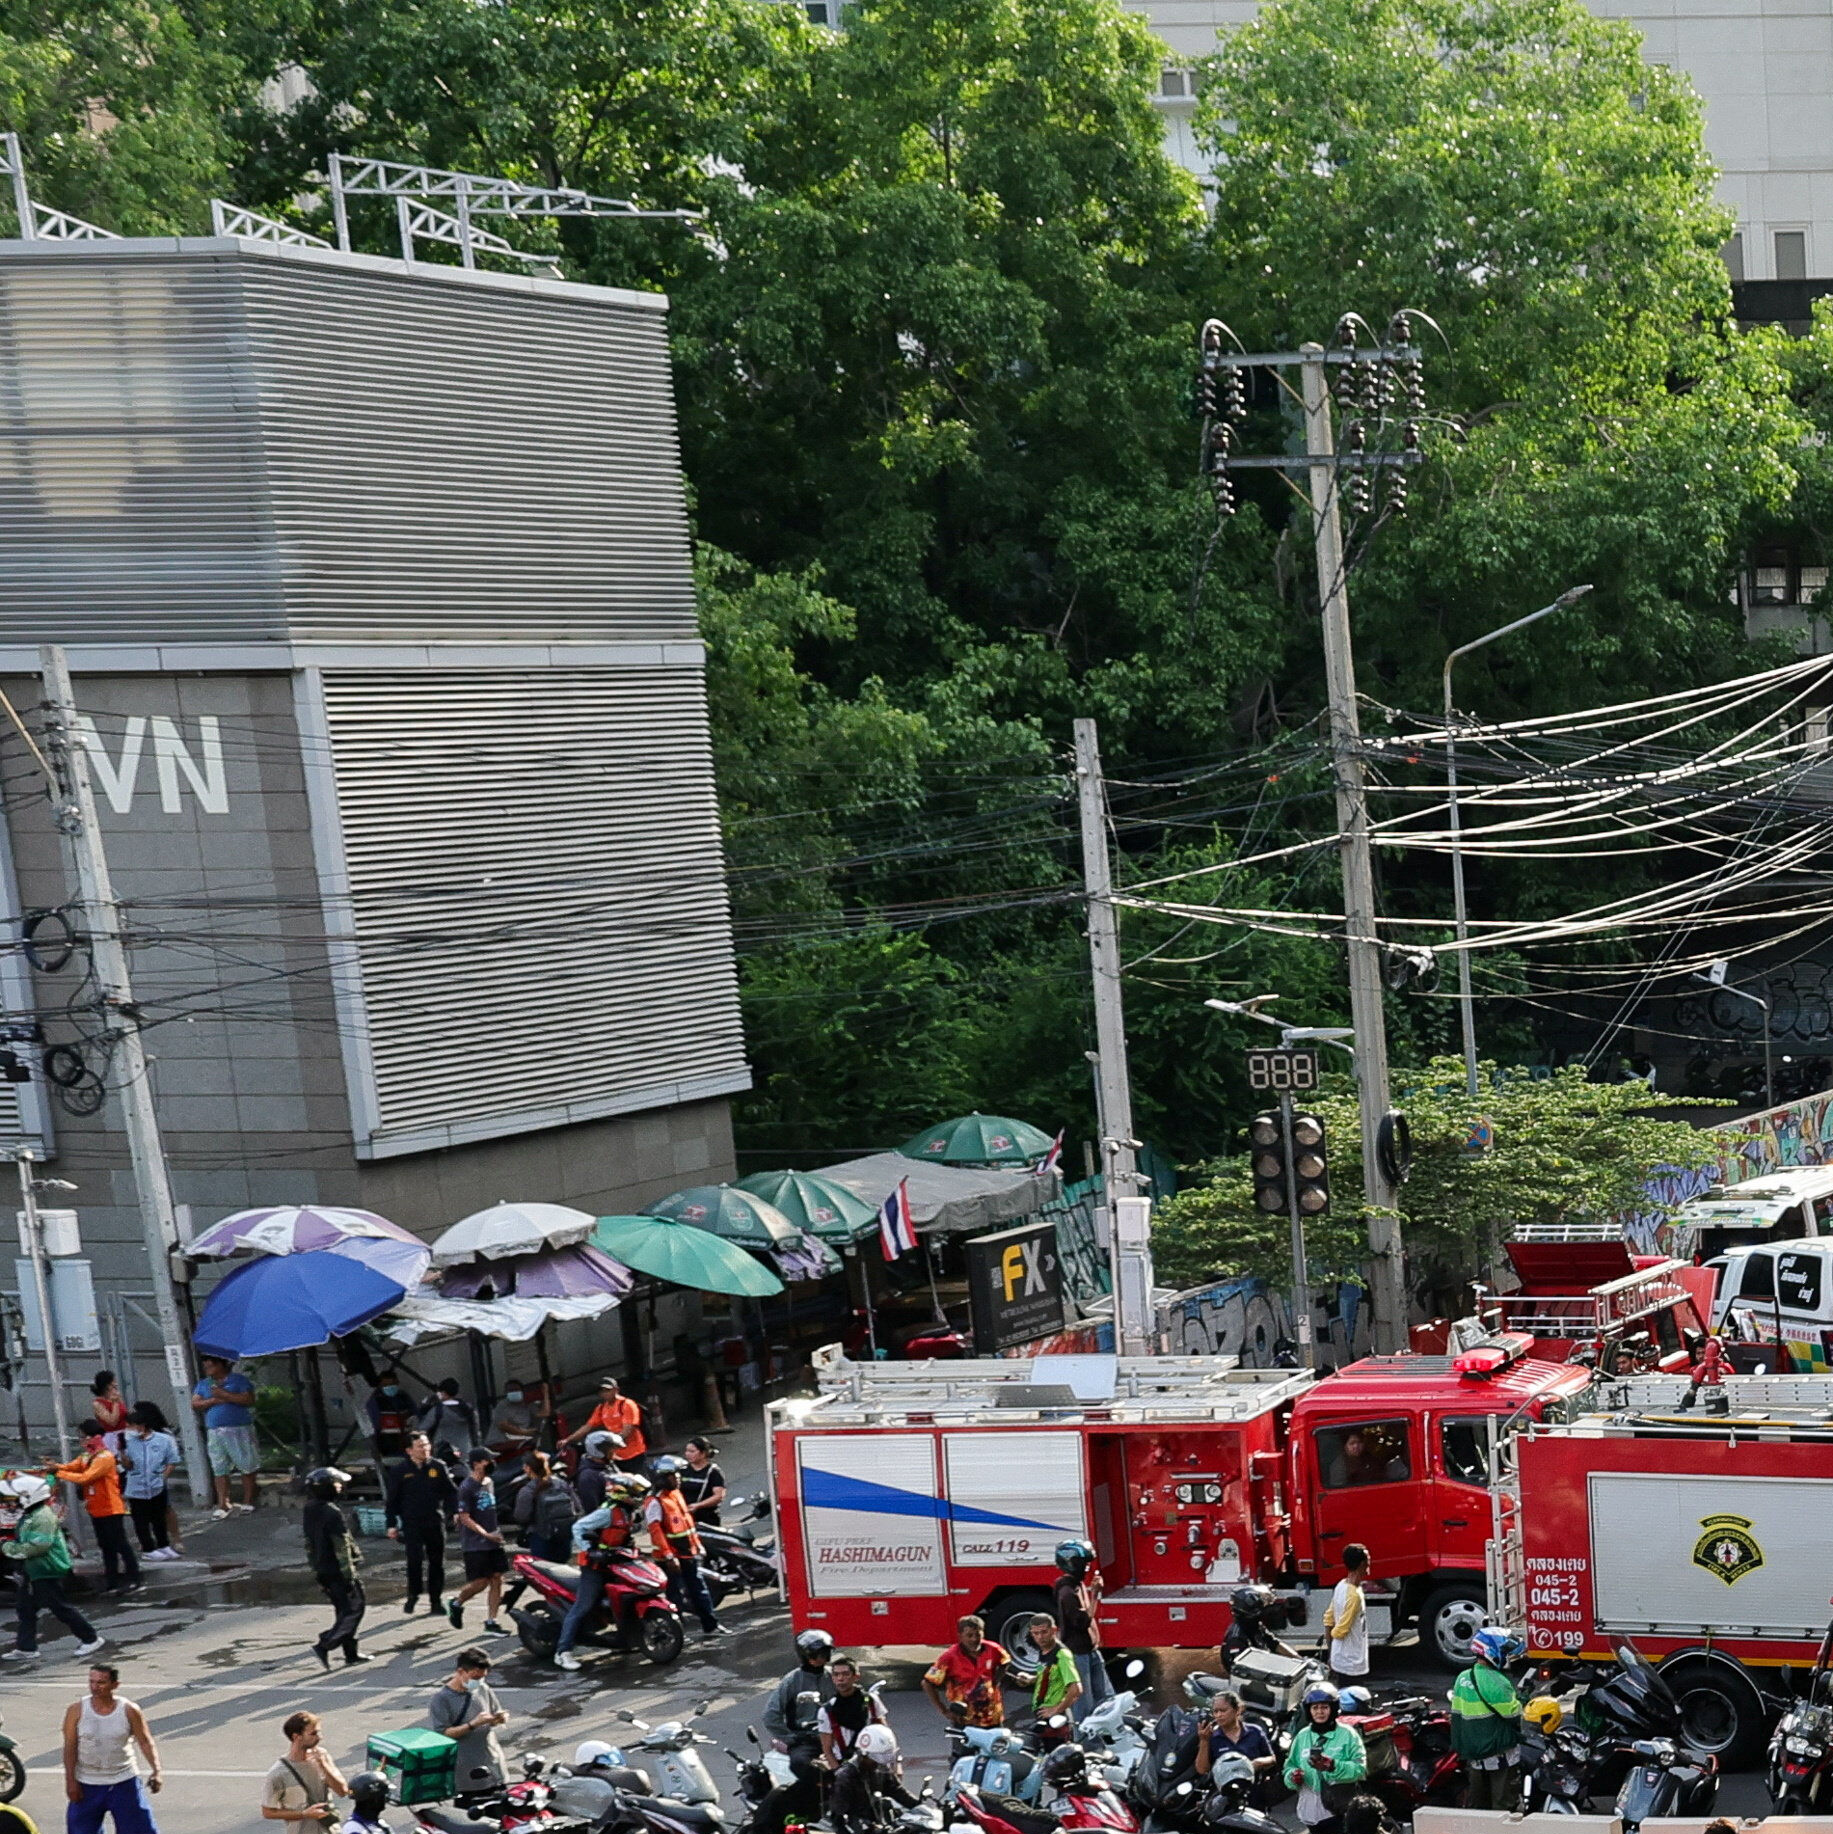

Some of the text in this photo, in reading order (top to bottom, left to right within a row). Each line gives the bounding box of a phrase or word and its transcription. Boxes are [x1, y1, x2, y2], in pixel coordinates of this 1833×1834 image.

[1001, 1239, 1046, 1302] FX
[963, 1539, 1030, 1553] CALL 119
[820, 1545, 933, 1564] HASHIMAGUN
[1526, 1557, 1587, 1573] คลองเตย
[1535, 1575, 1577, 1587] 045-2
[1530, 1588, 1580, 1606] 045-2
[1530, 1609, 1582, 1622] คลองเตย
[1553, 1630, 1584, 1647] 199
